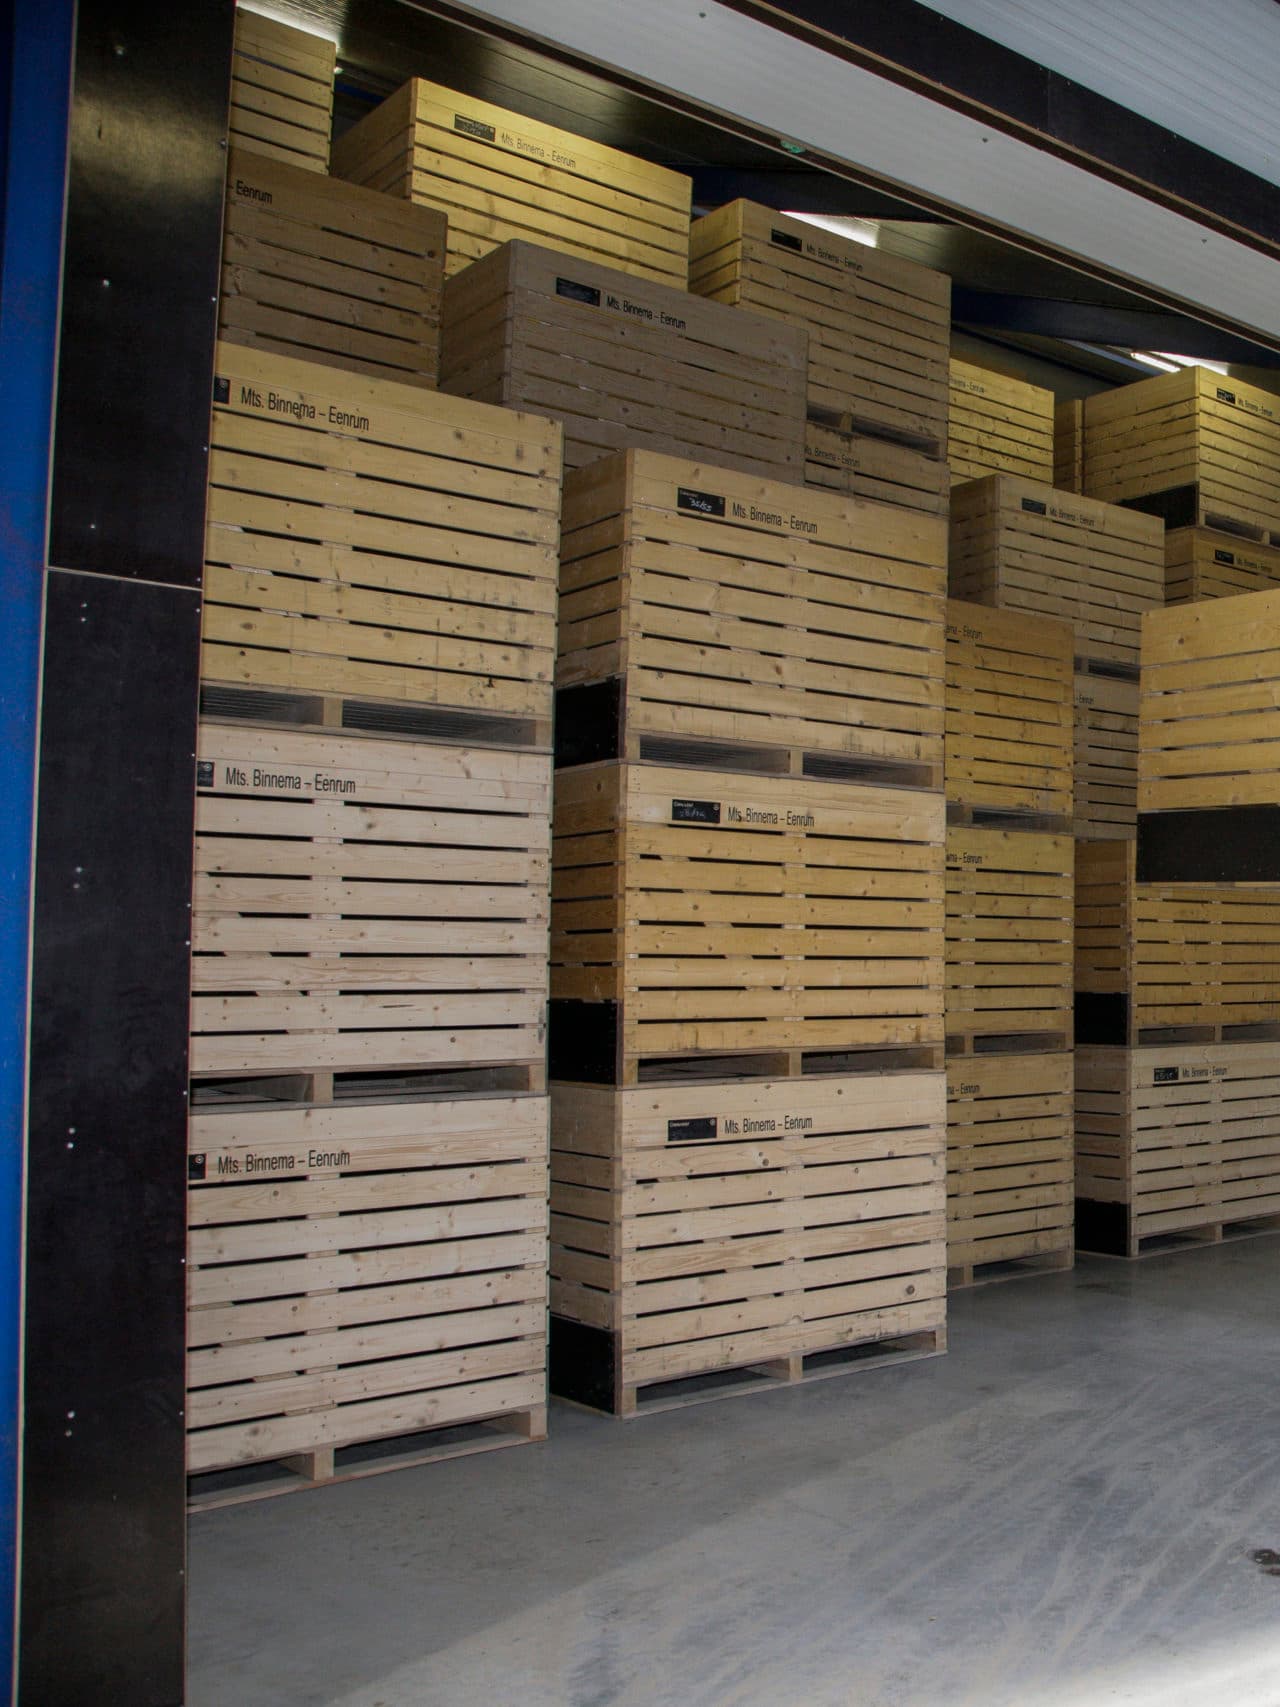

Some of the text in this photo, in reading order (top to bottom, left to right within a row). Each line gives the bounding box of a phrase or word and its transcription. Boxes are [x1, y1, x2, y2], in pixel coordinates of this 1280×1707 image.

[517, 138, 545, 157] Binnema
[551, 150, 576, 168] Eenrum
[236, 180, 272, 205] Eenrum
[607, 295, 621, 311] Mts.
[623, 300, 653, 320] Binnema
[660, 311, 686, 329] Eenrum
[241, 386, 264, 408] Mts.
[268, 392, 316, 419] Binnema
[328, 406, 369, 431] Eenrum
[732, 502, 747, 519] Mts.
[750, 506, 782, 527] Binnema
[790, 516, 817, 534] Eenrum
[225, 767, 249, 786] Mts.
[253, 769, 301, 789] Binnema
[315, 773, 356, 793] Eenrum
[728, 807, 745, 823] Mts.
[746, 808, 778, 824] Binnema
[786, 811, 815, 827] Eenrum
[724, 1119, 740, 1134] Mts.
[743, 1118, 776, 1133] Binnema
[784, 1115, 812, 1130] Eenrum
[218, 1156, 242, 1175] Mts.
[246, 1153, 295, 1172] Binnema
[308, 1150, 350, 1168] Eenrum
